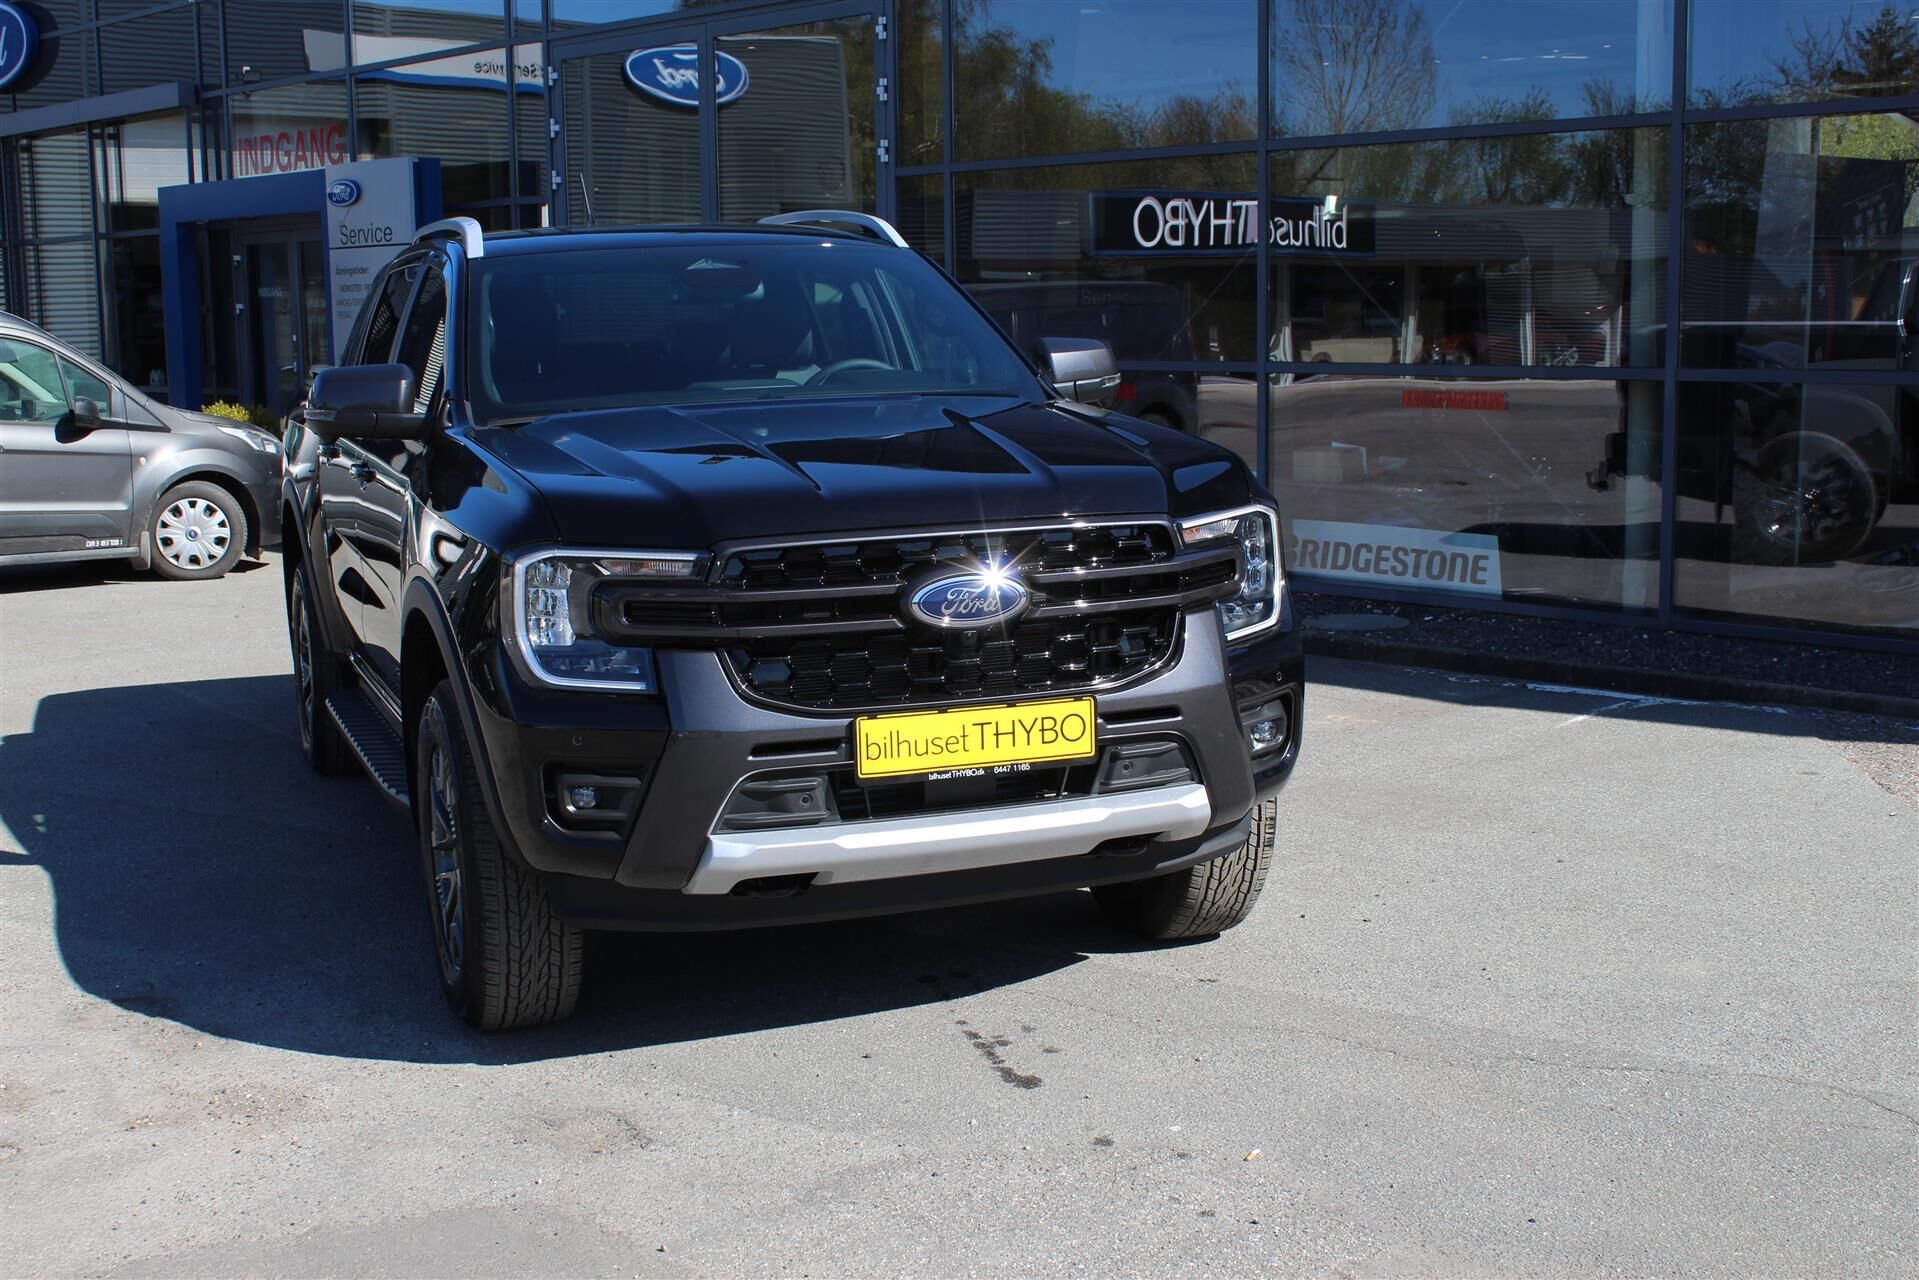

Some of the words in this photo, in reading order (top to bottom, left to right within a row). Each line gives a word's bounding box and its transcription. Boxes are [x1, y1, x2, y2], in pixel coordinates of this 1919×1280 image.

[238, 124, 344, 176] INDGANG
[339, 223, 393, 246] Service
[941, 583, 1002, 615] Ford
[993, 764, 1012, 774] 6447
[1013, 762, 1031, 772] 1165
